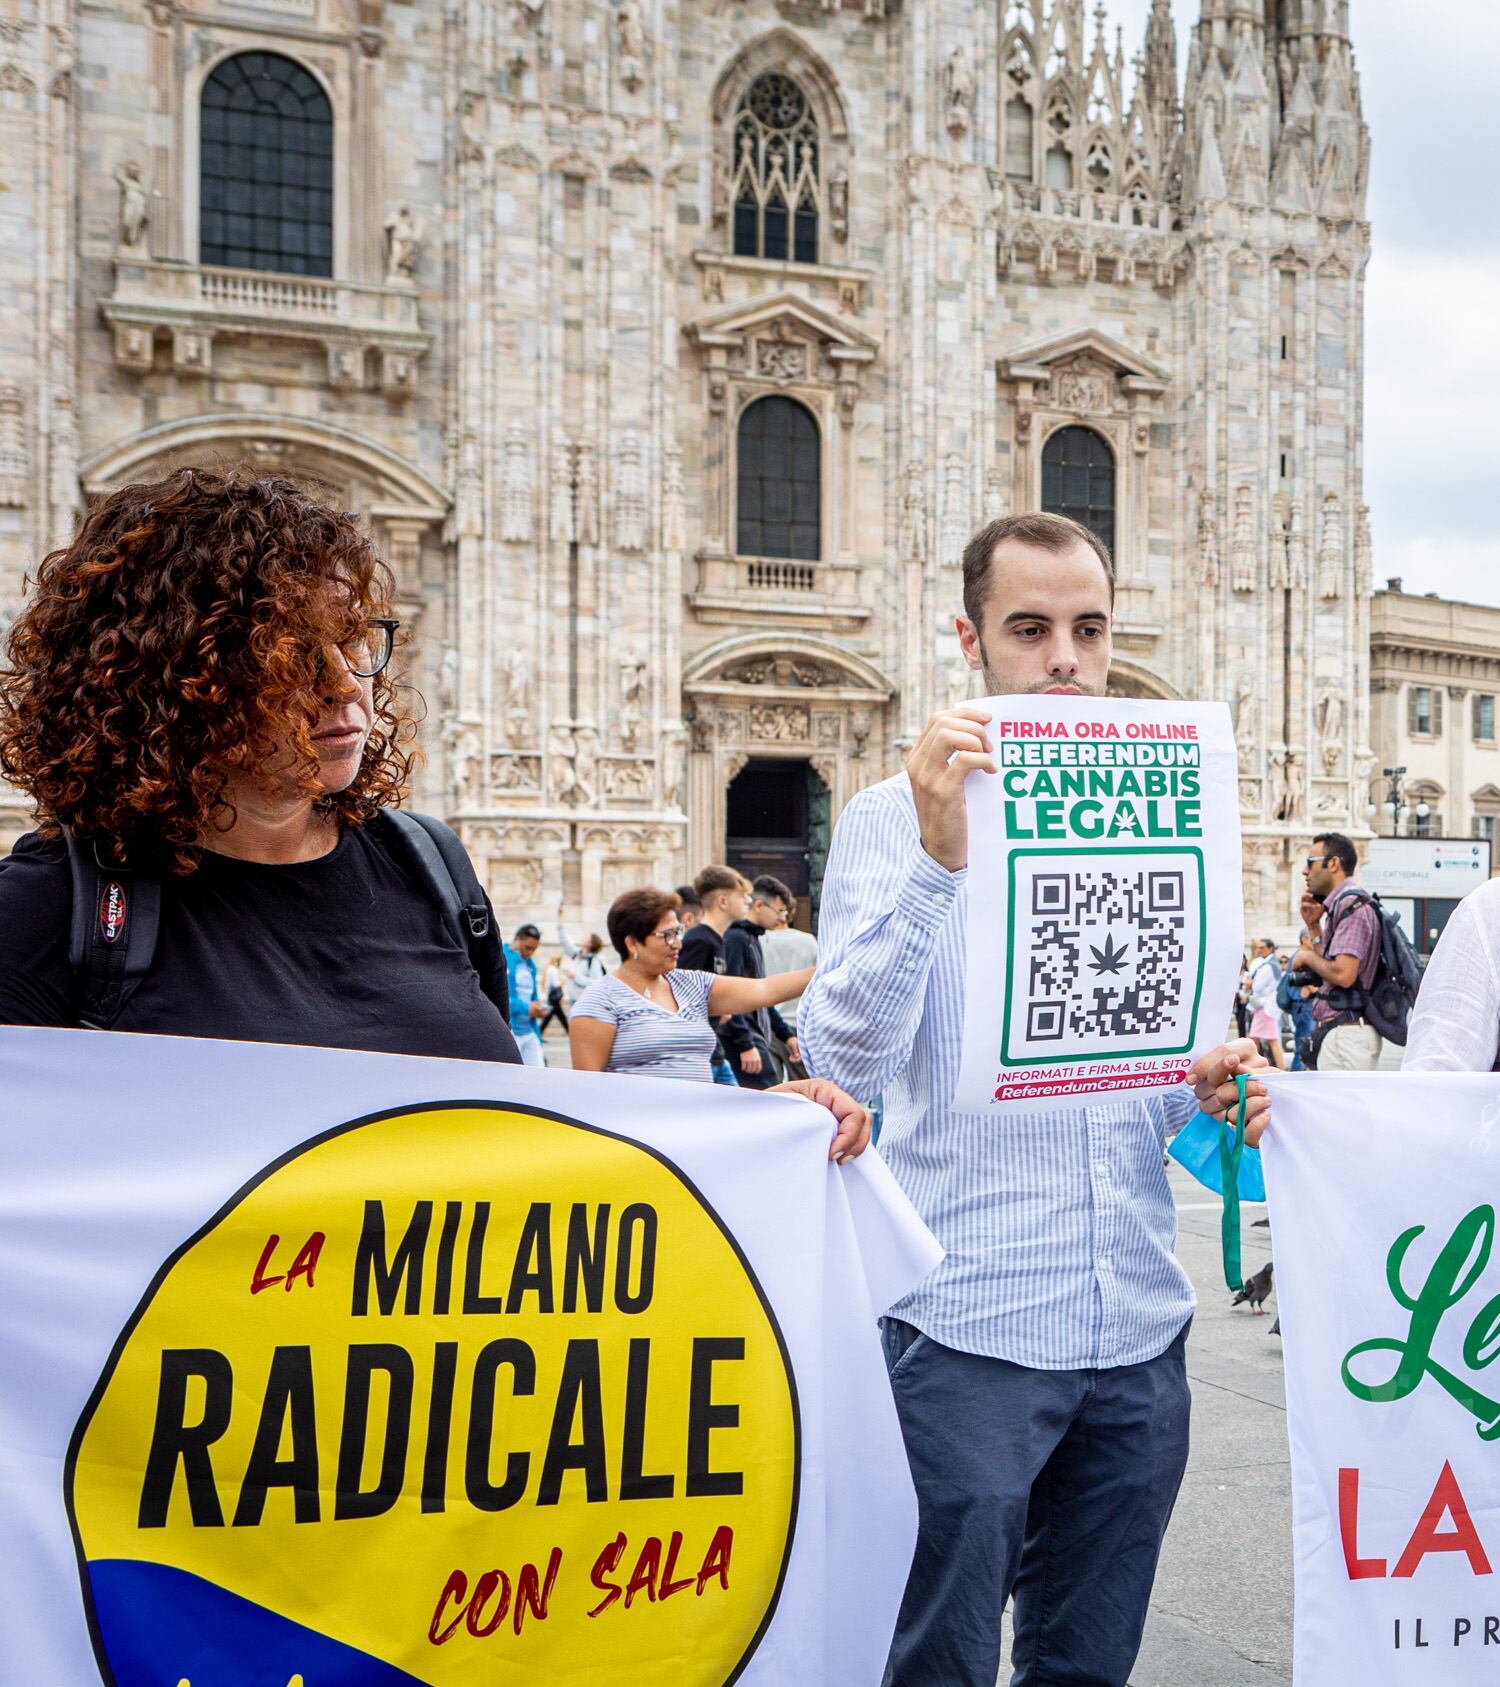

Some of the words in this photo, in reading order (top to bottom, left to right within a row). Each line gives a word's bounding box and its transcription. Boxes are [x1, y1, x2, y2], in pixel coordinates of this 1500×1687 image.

[1000, 721, 1069, 738] FIRMA
[1074, 722, 1121, 739] ORA
[1125, 723, 1199, 740] ONLINE
[1002, 743, 1200, 766] REFERENDUM
[1003, 769, 1201, 798] CANNABIS
[1004, 799, 1203, 840] LEGALE
[106, 886, 119, 938] EASTPAK
[996, 1068, 1073, 1083] INFORMATI
[1077, 1066, 1086, 1076] E
[1088, 1063, 1132, 1075] FIRMA
[1133, 1060, 1158, 1072] SUL
[1162, 1058, 1191, 1069] SITO
[1001, 1072, 1179, 1099] ReferendumCannabis.it
[251, 1232, 325, 1295] LA
[351, 1200, 658, 1317] MILANO
[138, 1337, 745, 1529] RADICALE
[1338, 1460, 1493, 1581] LA
[428, 1547, 563, 1646] CON
[587, 1525, 734, 1618] SALA
[1394, 1618, 1429, 1649] IL
